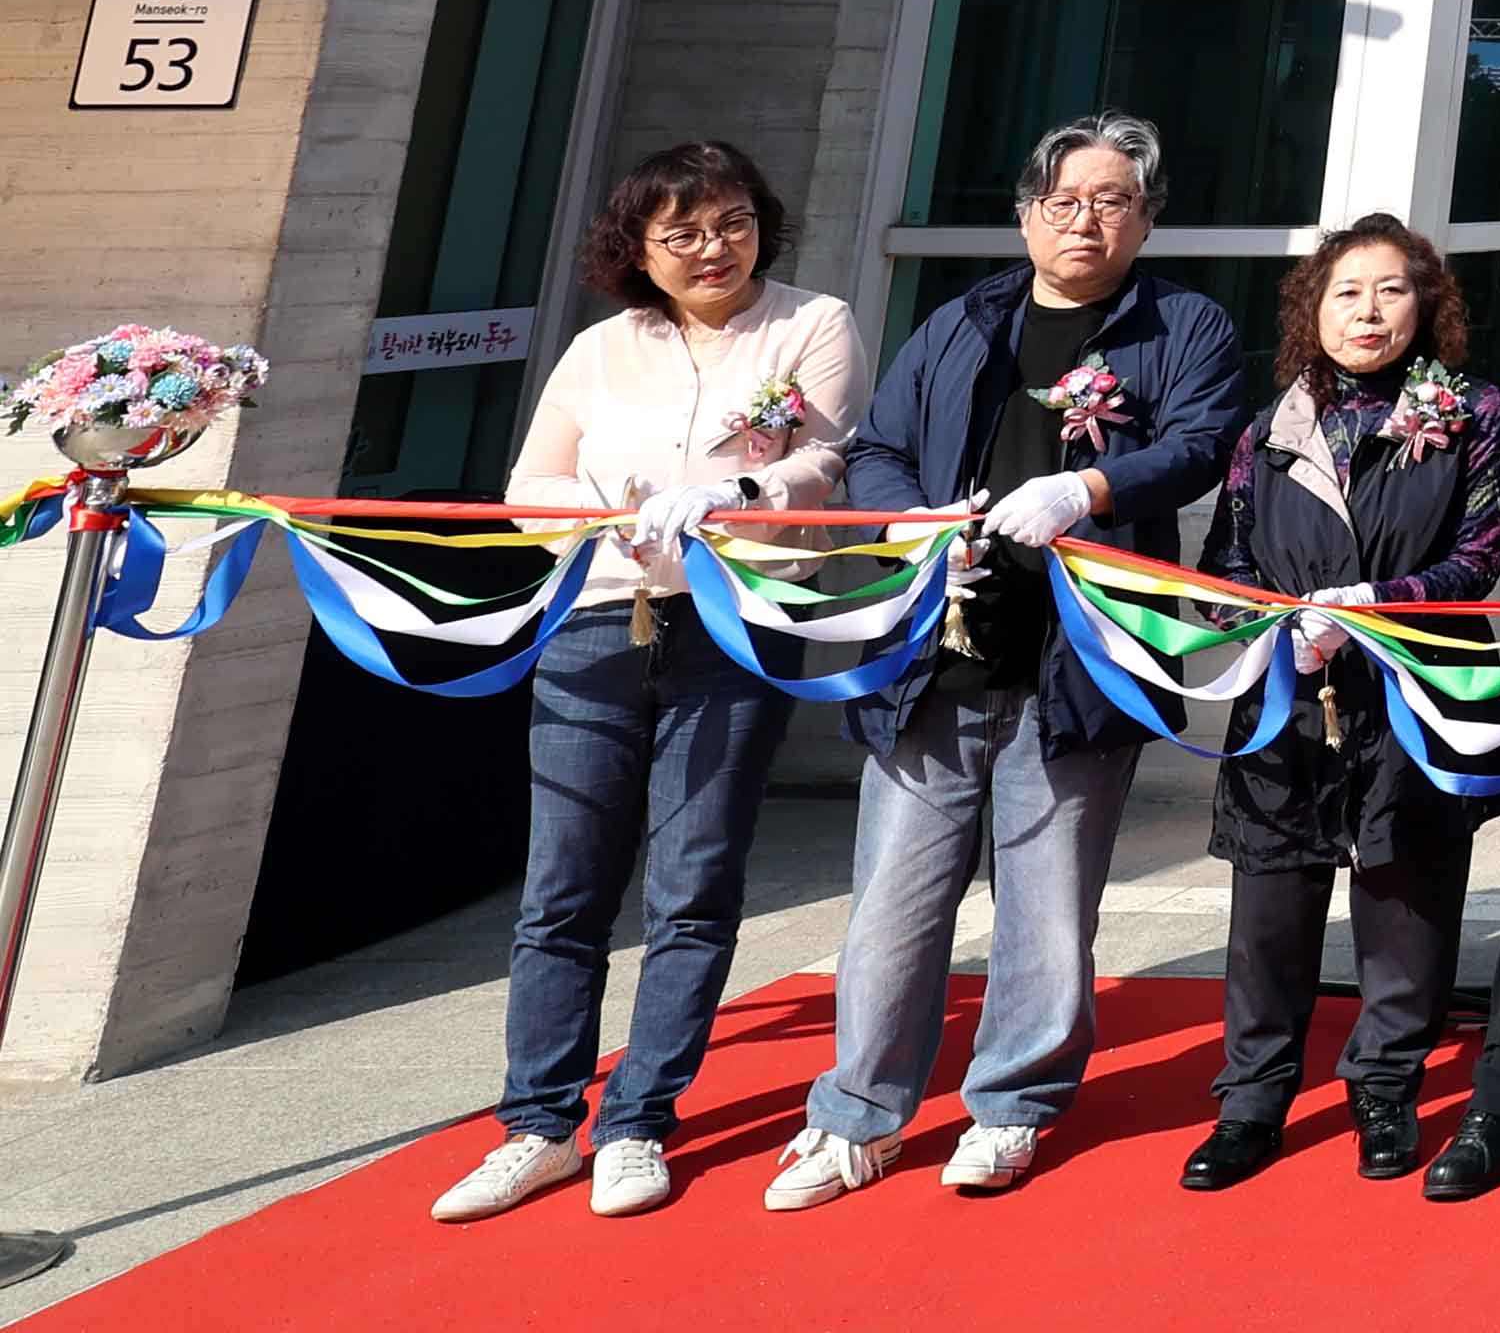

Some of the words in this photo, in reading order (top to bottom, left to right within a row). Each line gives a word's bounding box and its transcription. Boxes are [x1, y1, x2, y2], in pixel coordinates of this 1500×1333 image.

[135, 4, 209, 15] Manseok-ro
[119, 37, 199, 92] 53
[482, 321, 520, 355] 동구
